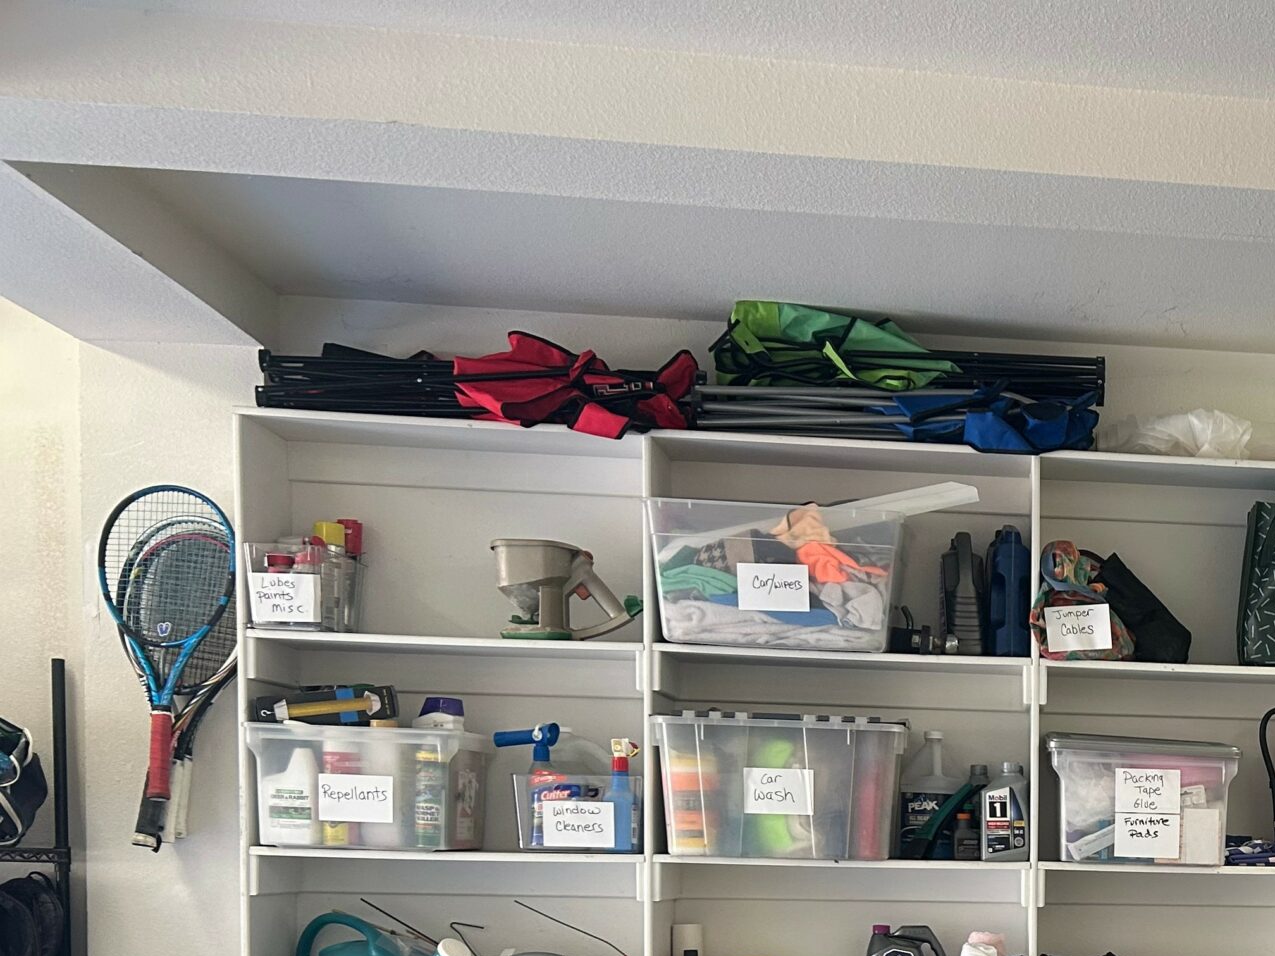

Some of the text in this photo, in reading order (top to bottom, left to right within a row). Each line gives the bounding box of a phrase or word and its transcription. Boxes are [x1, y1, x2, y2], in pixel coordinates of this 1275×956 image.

[261, 577, 296, 589] Lubes
[1052, 609, 1095, 622] Jumper
[1060, 623, 1095, 636] Cables
[1123, 771, 1164, 787] Packing
[321, 783, 388, 803] Repellants
[541, 789, 571, 801] Cutter
[1134, 785, 1162, 796] Tape
[908, 800, 940, 812] PEAK
[993, 802, 1001, 817] 1
[1133, 799, 1158, 810] Glue
[556, 821, 604, 833] Cleaners
